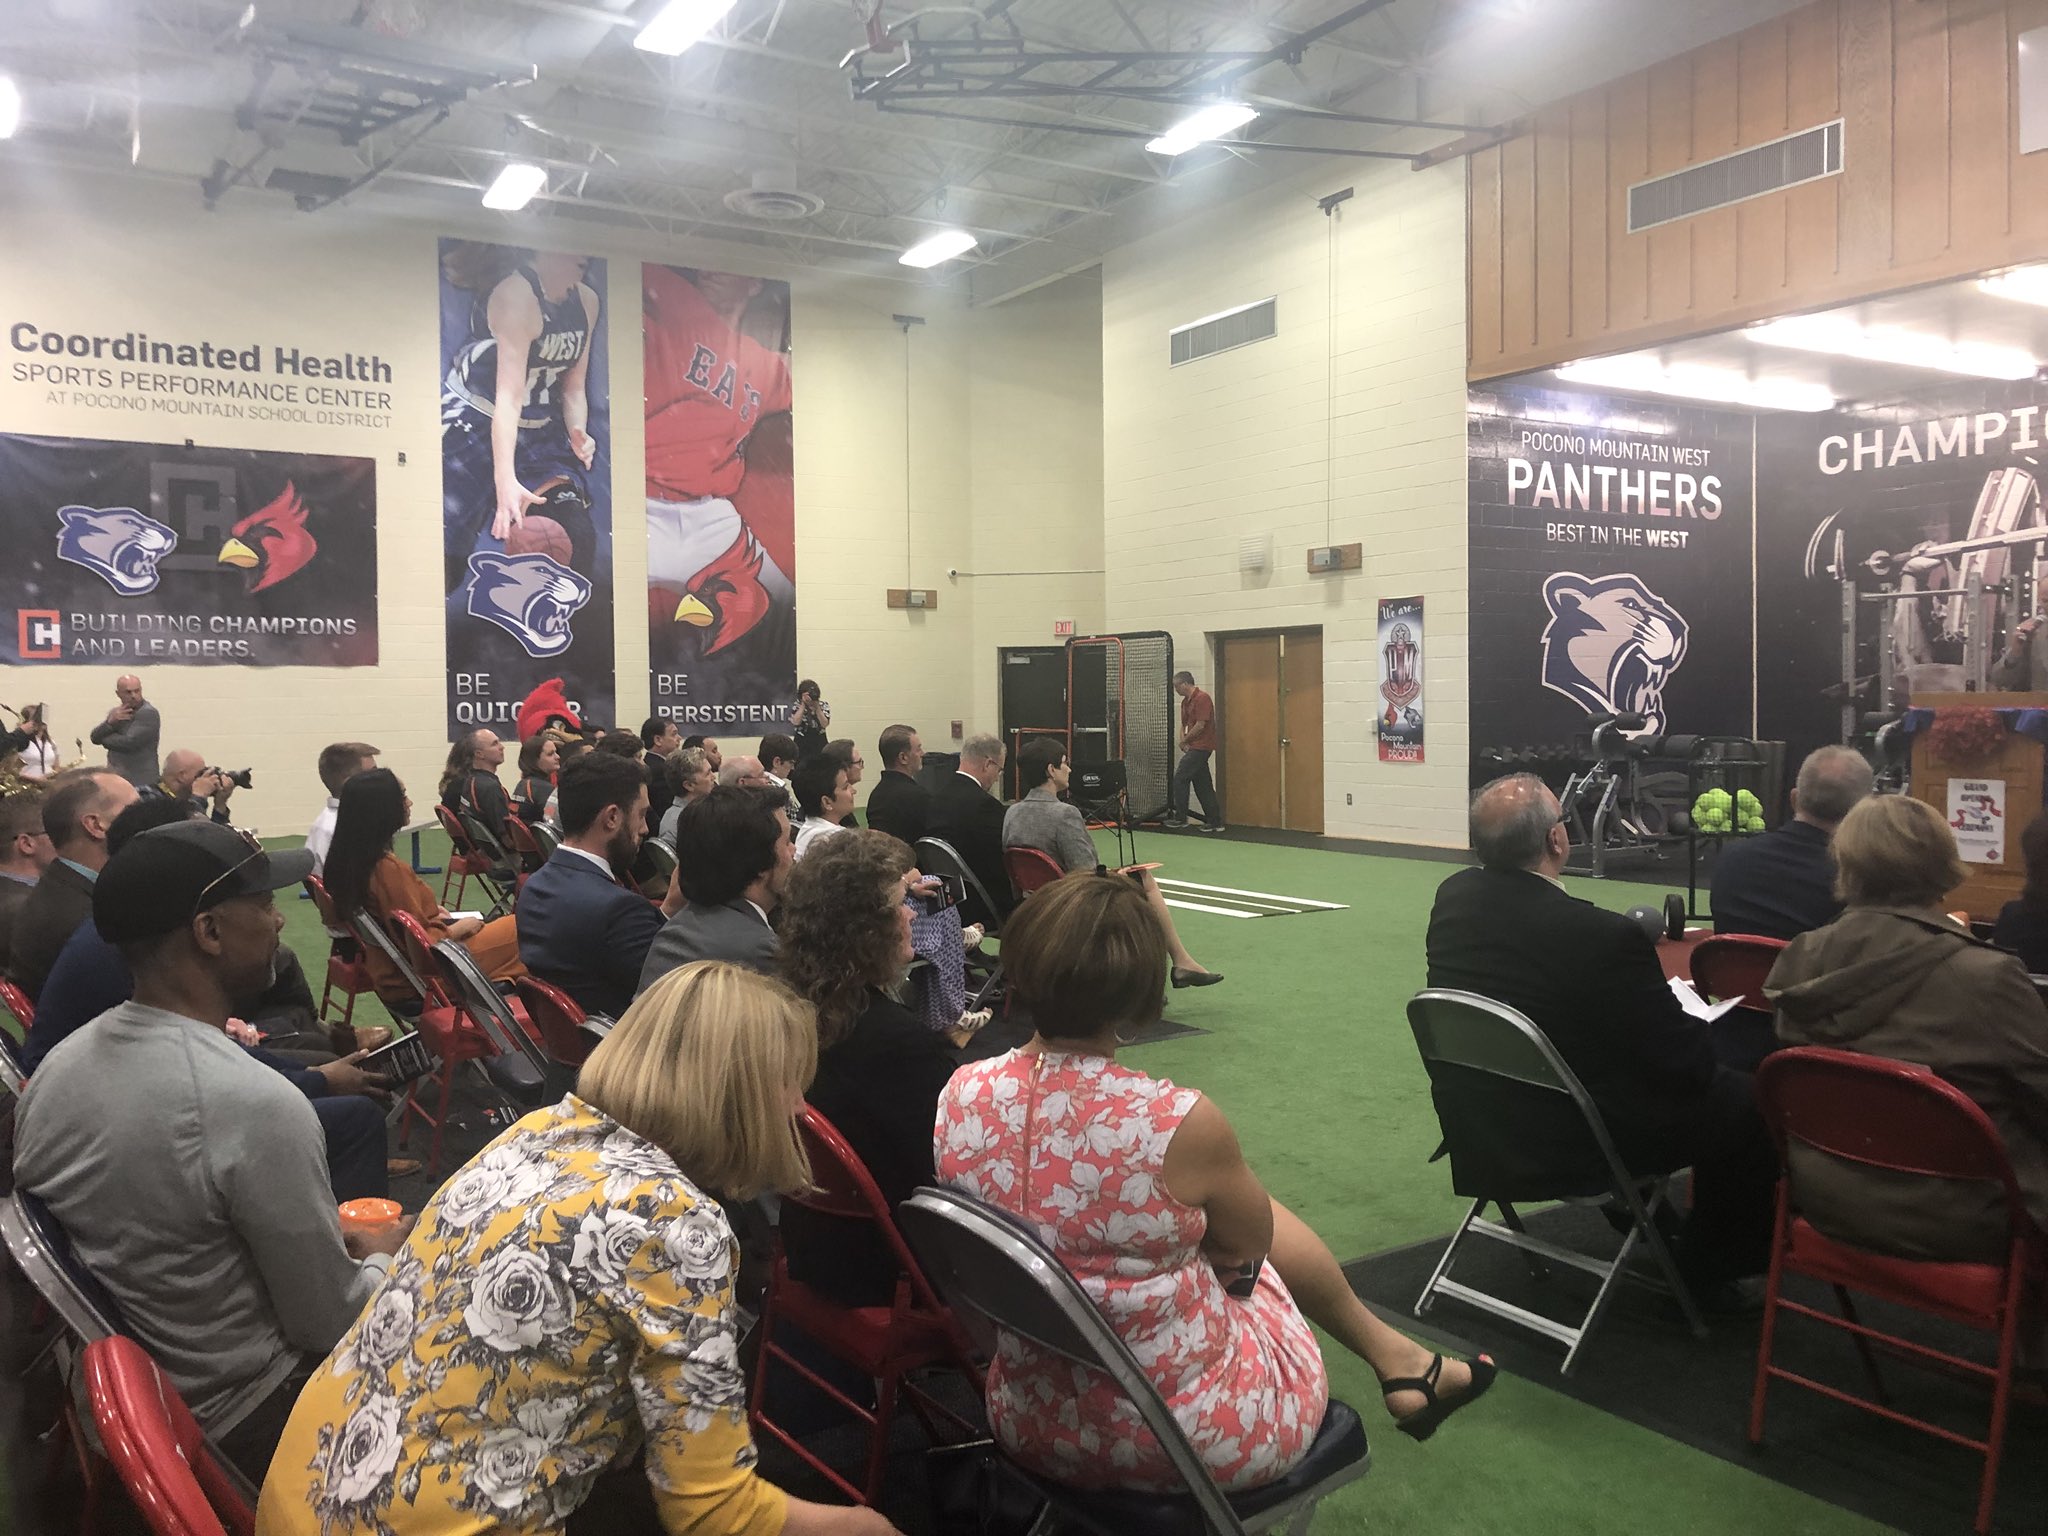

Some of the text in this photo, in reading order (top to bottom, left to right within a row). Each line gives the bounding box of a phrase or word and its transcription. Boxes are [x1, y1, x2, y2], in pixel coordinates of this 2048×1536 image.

[10, 321, 393, 384] Coordinated Health
[539, 330, 585, 361] WEST
[12, 362, 393, 410] SPORTS PERFORMANCE CENTER
[46, 390, 393, 430] AT POCONO MOUNTAIN SCHOOL DISTRICT
[1521, 430, 1711, 467] POCONO MOUNTAIN WEST
[1818, 405, 2048, 475] CHAMPI
[1507, 457, 1723, 521] PANTHERS
[1546, 522, 1689, 549] BEST IN THE WEST
[71, 613, 357, 636] BUILDING CHAMPIONS
[1055, 620, 1072, 634] EXIT
[71, 638, 256, 659] AND LEADERS.
[456, 673, 490, 696] BE
[657, 674, 688, 695] BE
